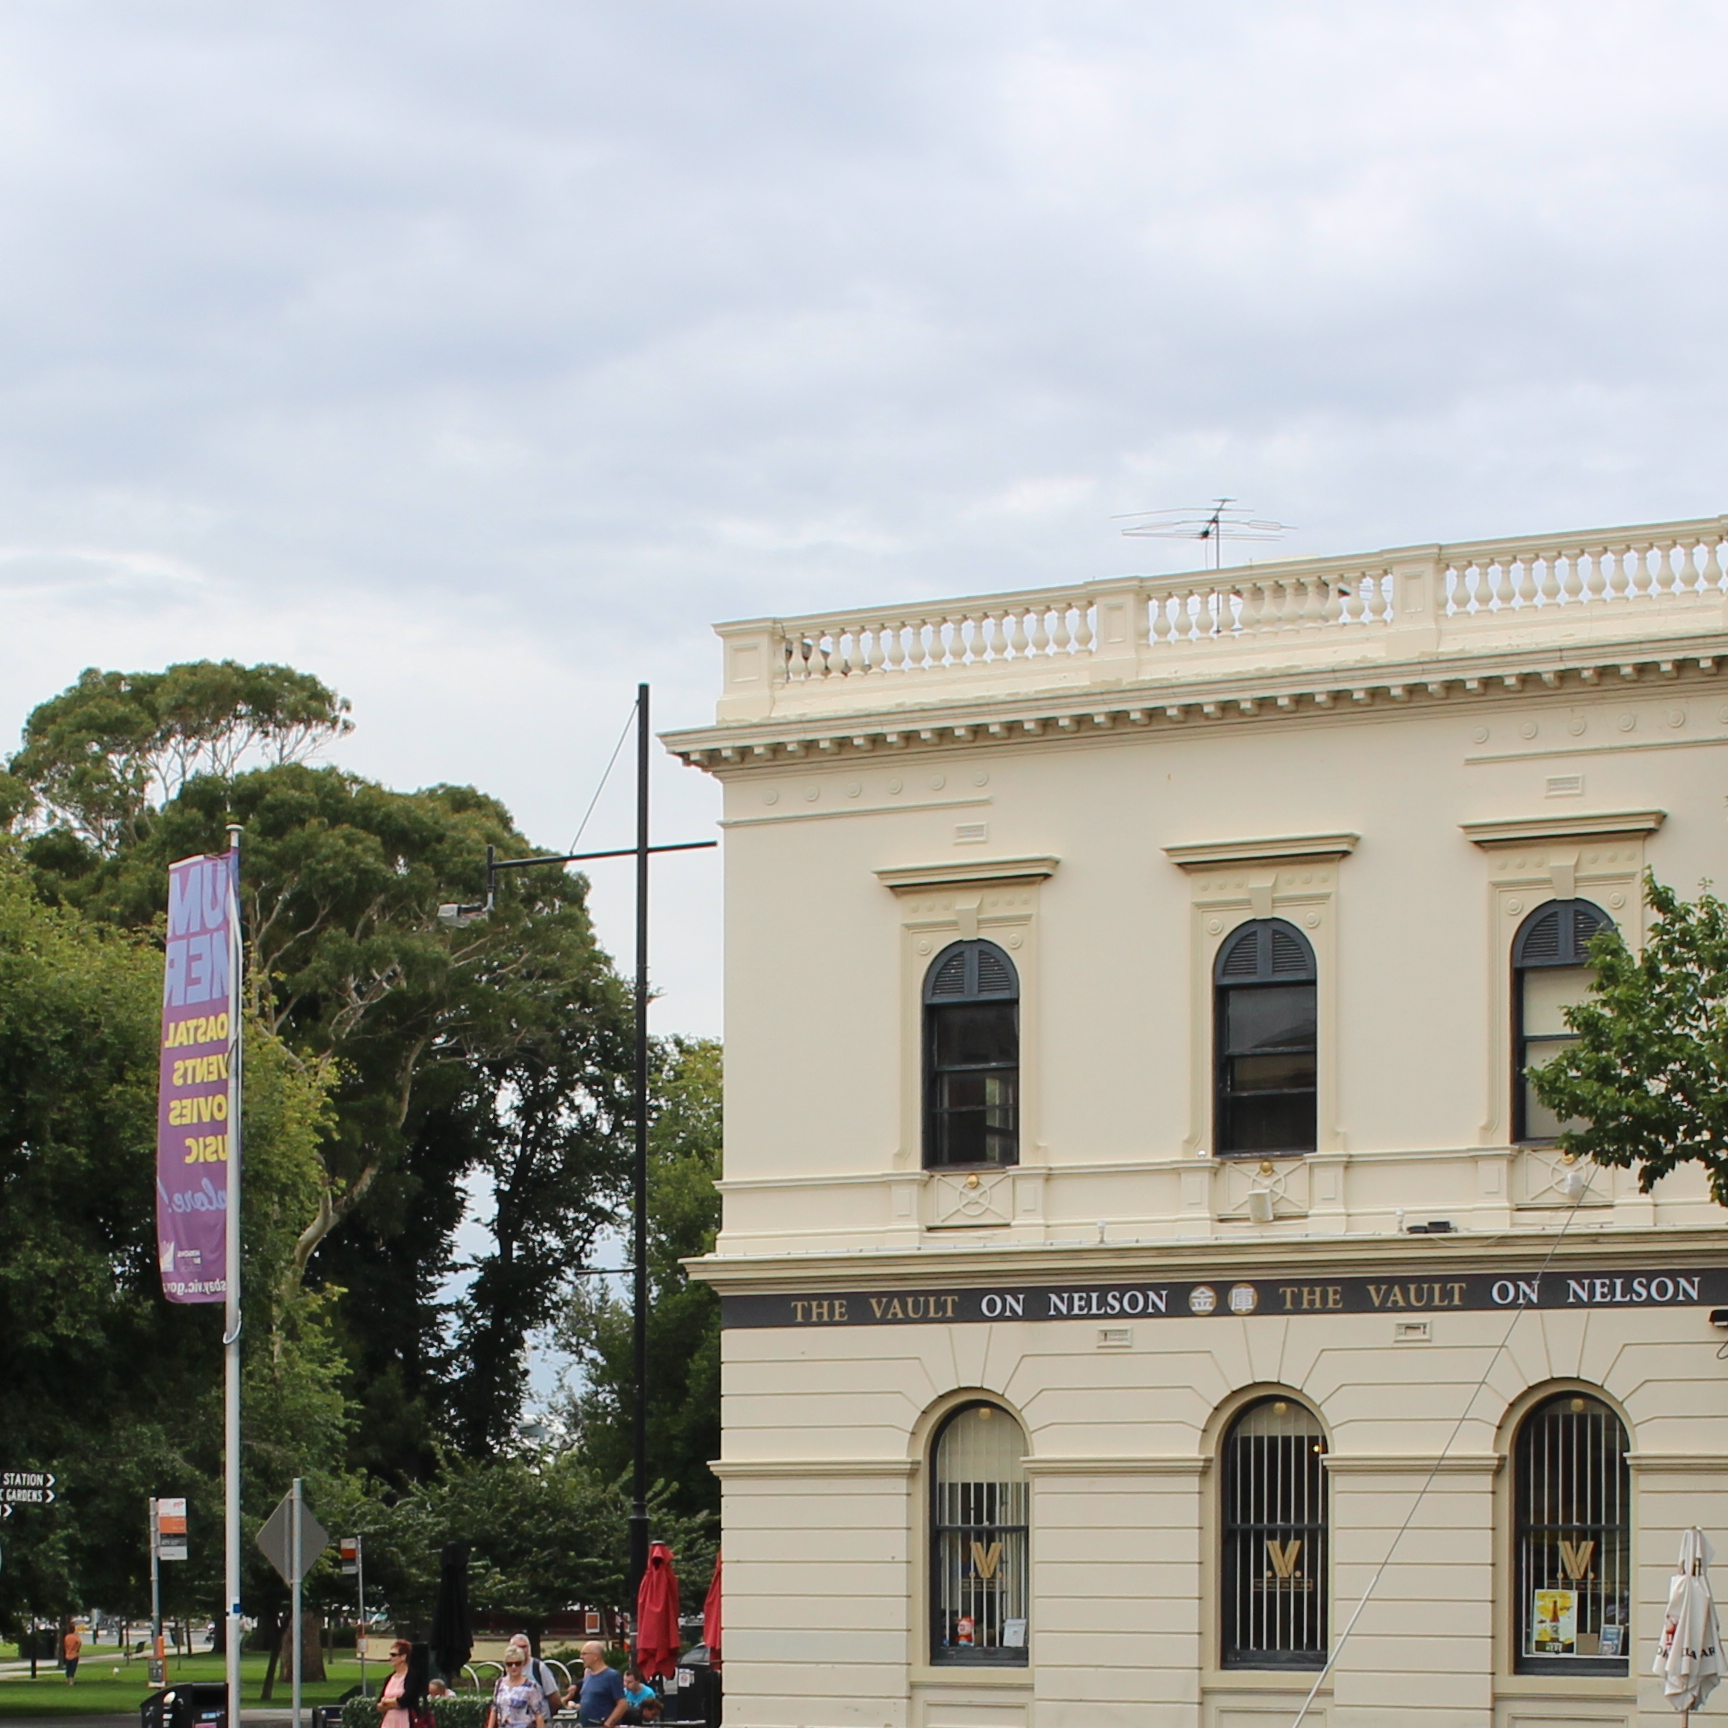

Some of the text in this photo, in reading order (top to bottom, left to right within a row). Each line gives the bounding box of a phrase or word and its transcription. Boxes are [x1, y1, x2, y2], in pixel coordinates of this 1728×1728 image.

[1278, 1277, 1701, 1309] THE VAULT ON NELSON
[791, 1290, 1168, 1322] THE VAULT ON NELSON
[3, 1472, 44, 1486] STATION
[6, 1488, 43, 1502] GARDENS
